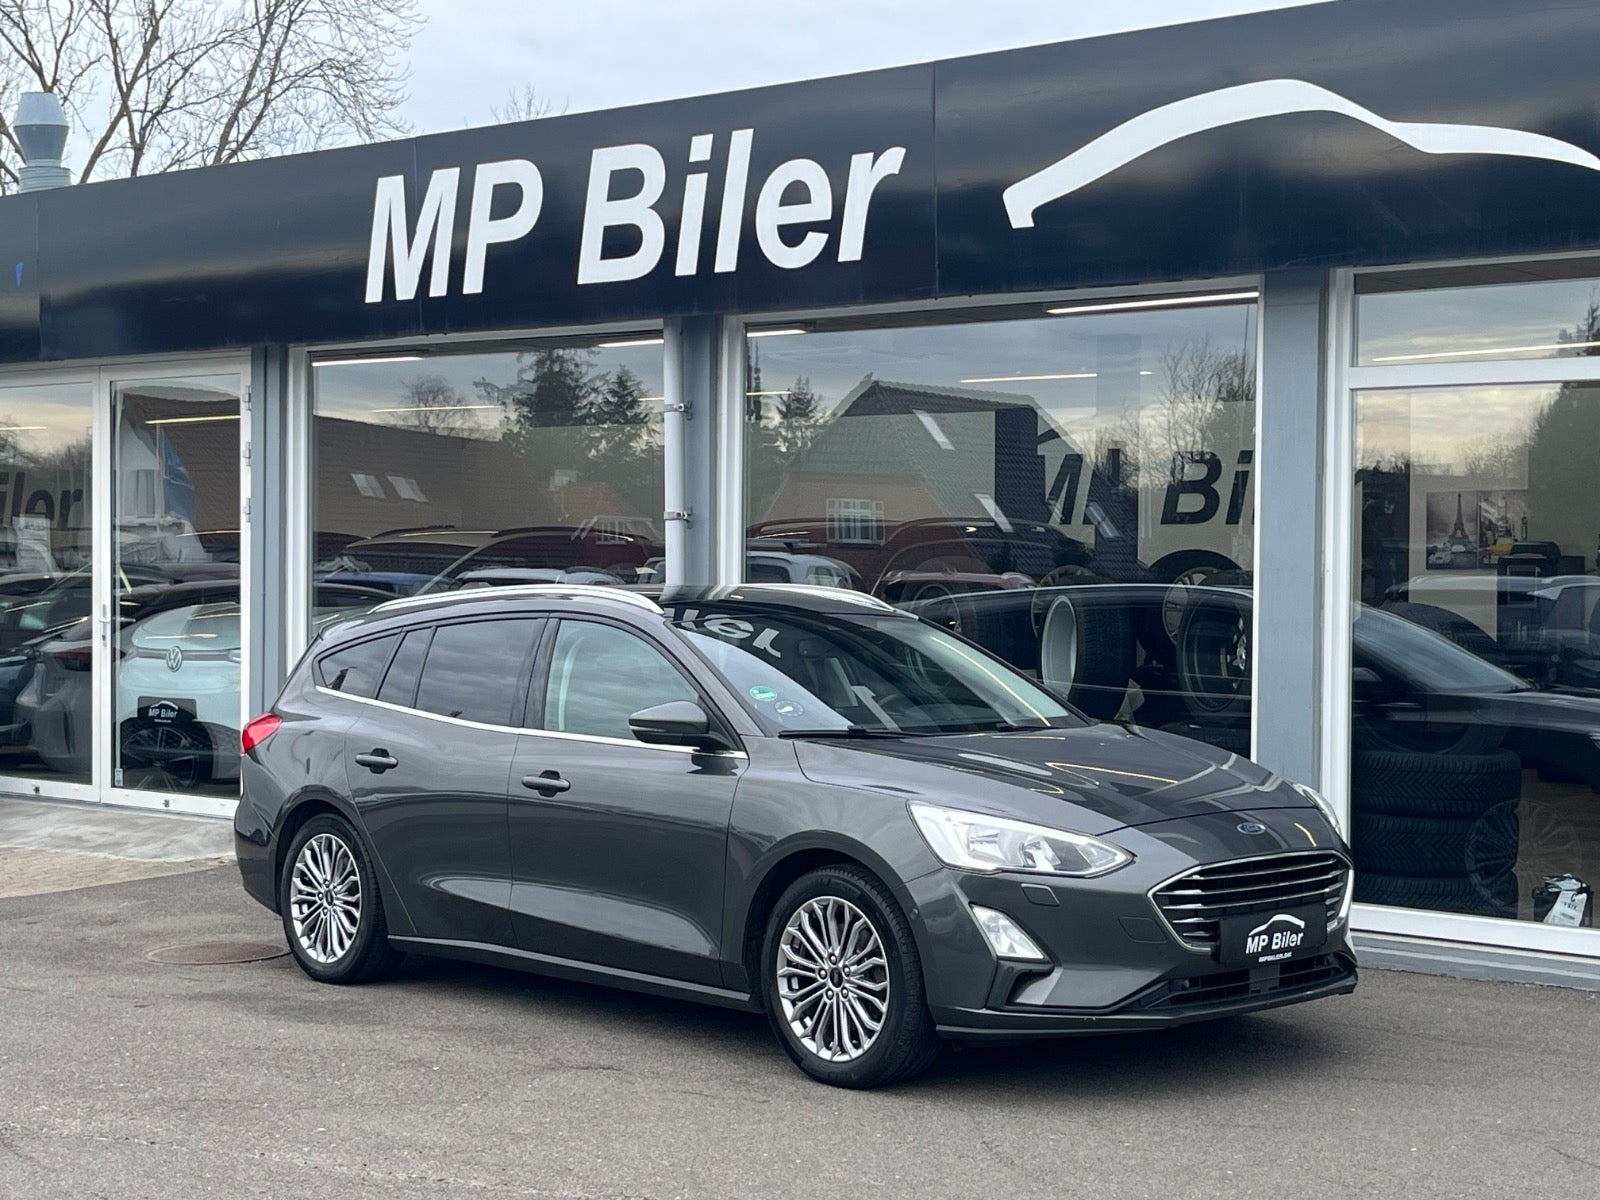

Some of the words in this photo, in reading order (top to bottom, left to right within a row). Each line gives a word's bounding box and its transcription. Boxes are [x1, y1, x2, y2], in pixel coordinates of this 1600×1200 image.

[364, 158, 543, 304] MP
[577, 129, 907, 285] Biler
[1160, 449, 1254, 525] Bi
[148, 708, 160, 716] MP
[1245, 935, 1268, 954] MP
[1271, 931, 1304, 950] Biler
